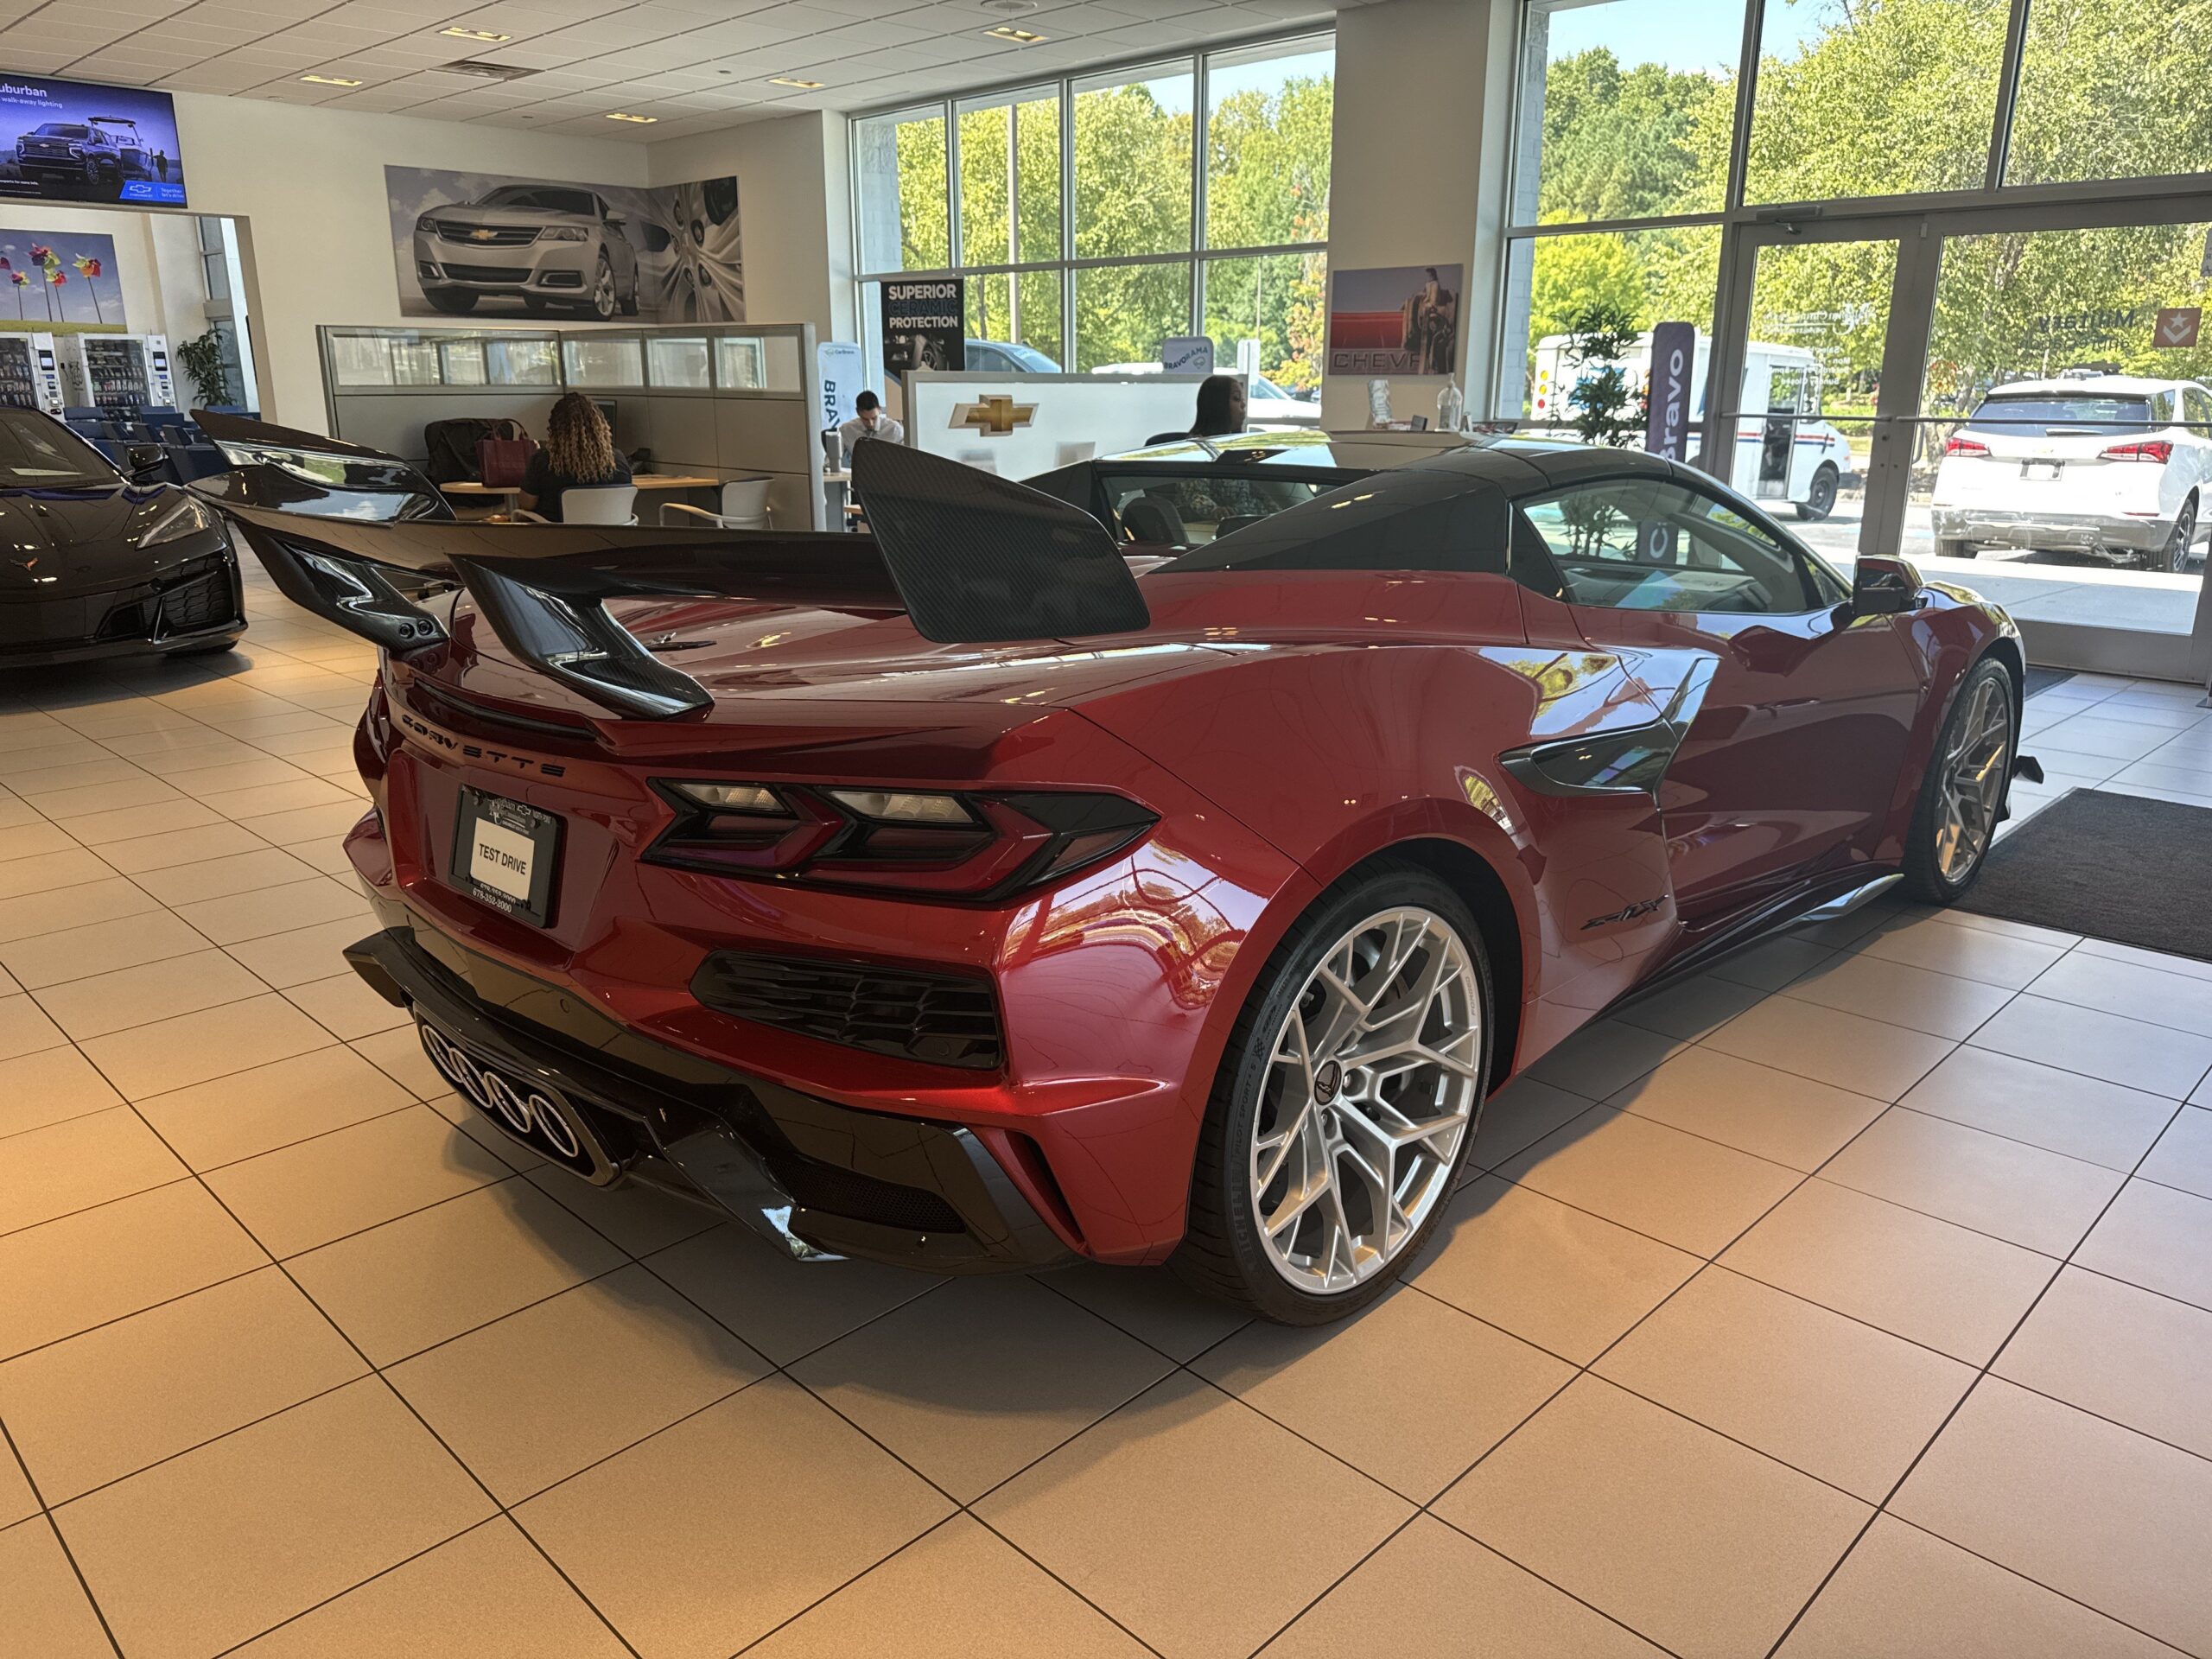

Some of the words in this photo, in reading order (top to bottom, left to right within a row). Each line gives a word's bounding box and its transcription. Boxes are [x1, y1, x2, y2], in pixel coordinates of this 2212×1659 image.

[37, 99, 63, 109] lighting
[888, 283, 957, 300] SUPERIOR
[888, 300, 957, 316] CERAMIC
[889, 315, 958, 328] PROTECTION
[1163, 346, 1208, 370] BRAVORAMA
[402, 715, 566, 778] CORVETTE
[479, 842, 500, 863] TEST
[501, 853, 526, 875] DRIVE
[473, 887, 512, 913] 678-352-2000
[1465, 976, 1476, 1016] FORGED
[1239, 1080, 1252, 1118] SPORT
